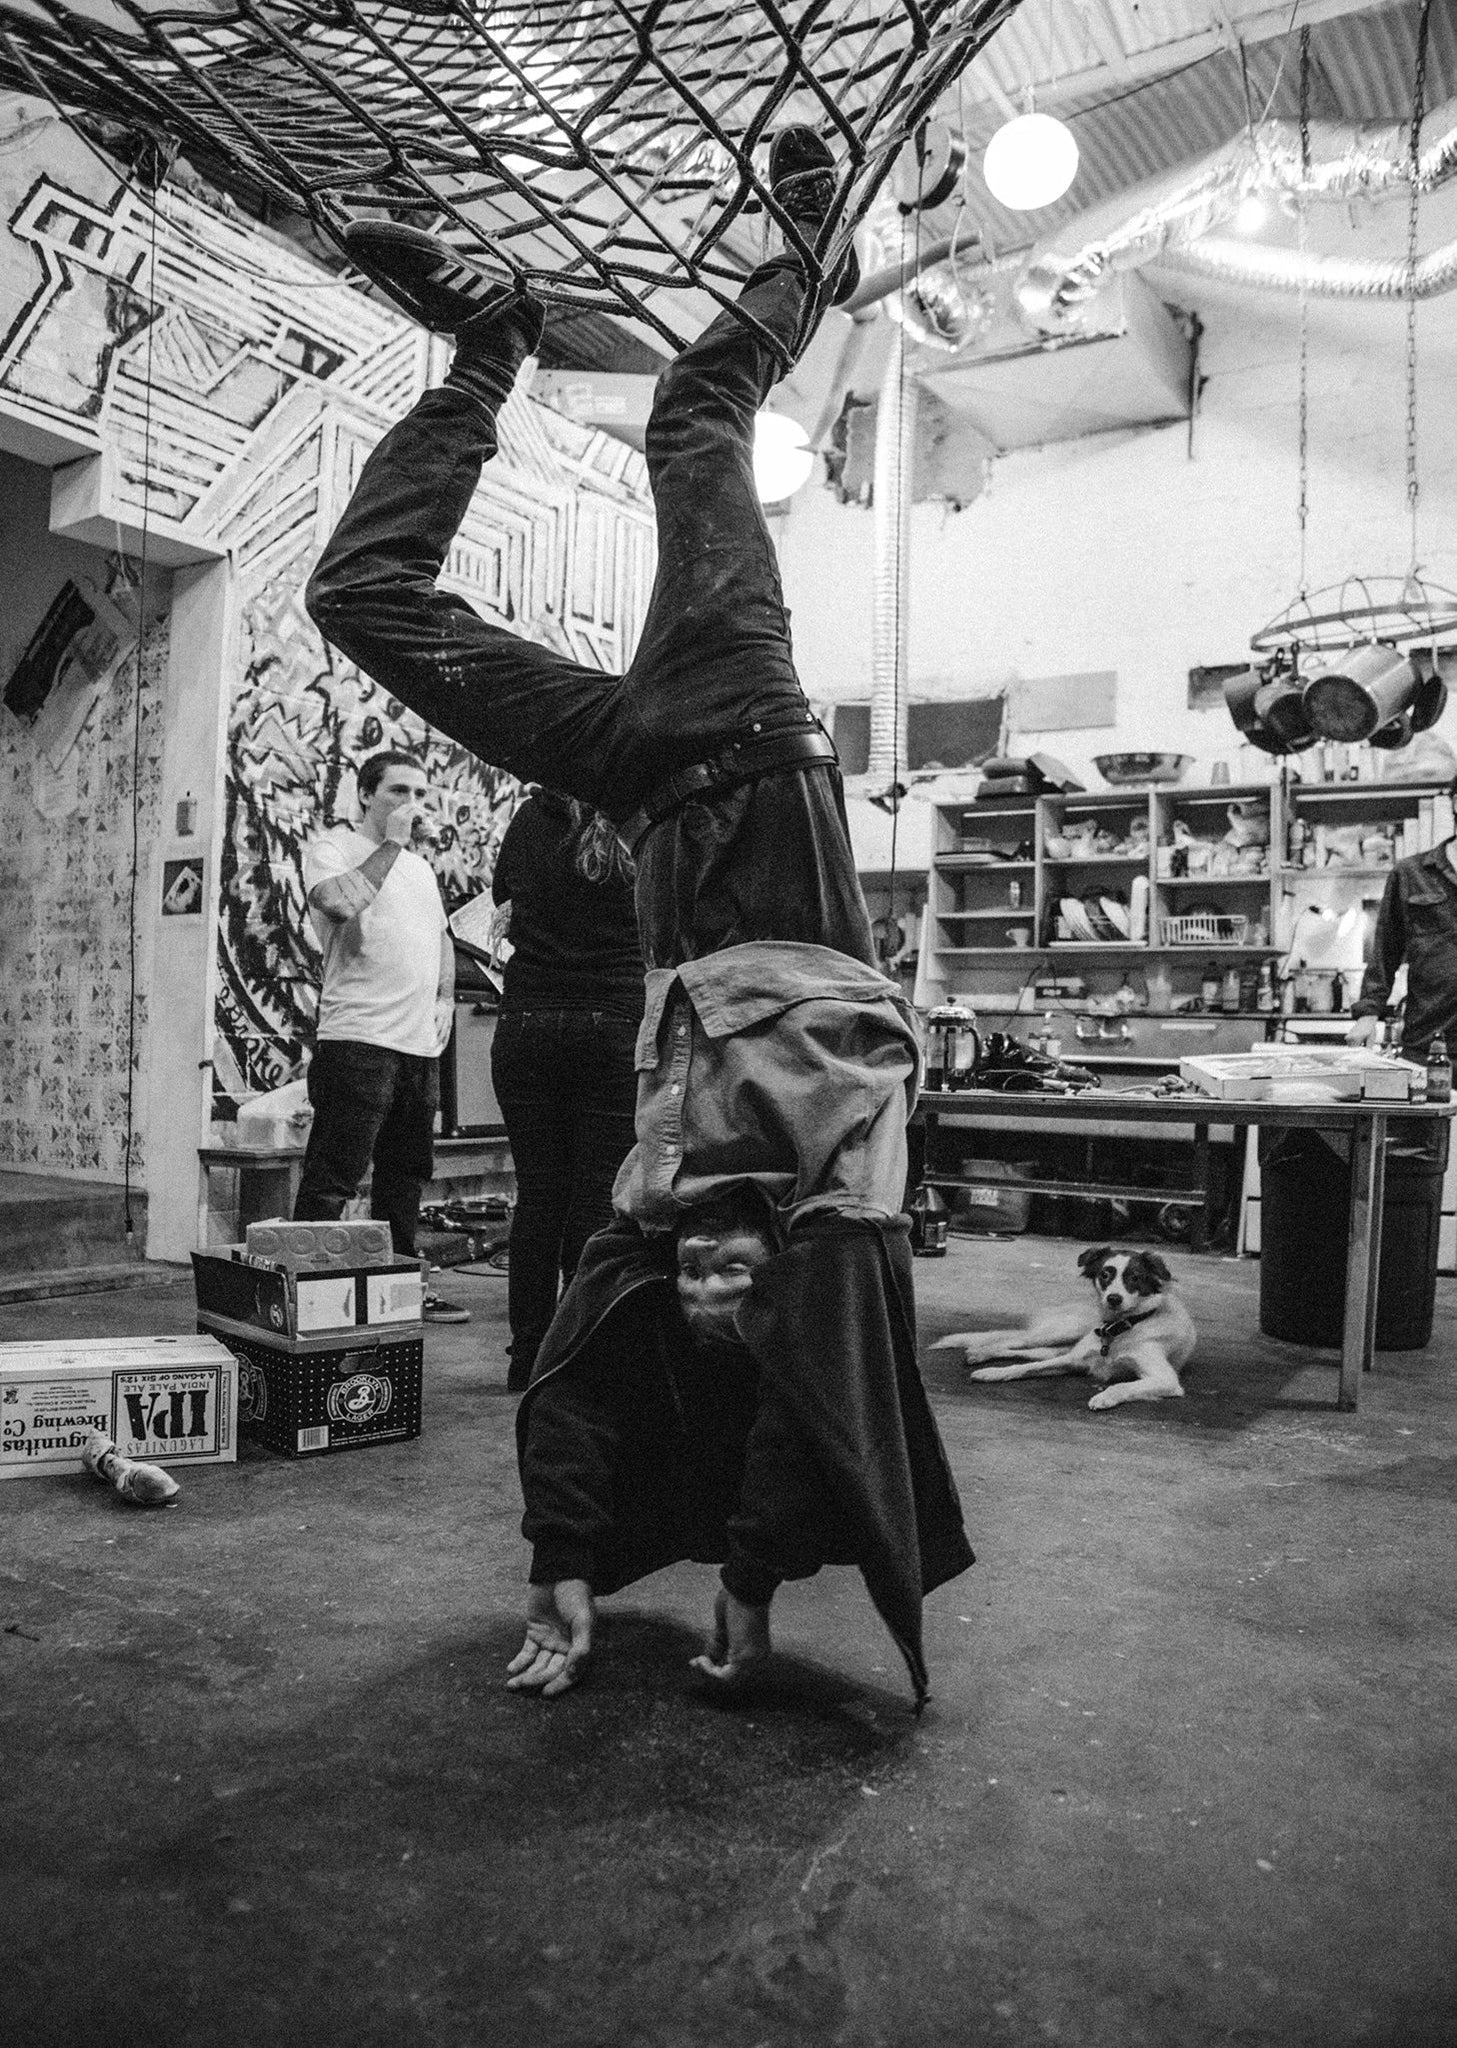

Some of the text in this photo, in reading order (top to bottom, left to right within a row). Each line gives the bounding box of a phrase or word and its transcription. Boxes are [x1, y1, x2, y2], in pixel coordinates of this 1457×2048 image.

[123, 1381, 210, 1392] INDIA PALE ALE
[341, 1375, 380, 1395] BROOKLYN
[33, 1413, 108, 1432] Brewing
[124, 1390, 209, 1441] IPA
[346, 1408, 374, 1421] LAGER
[2, 1433, 88, 1457] gunitas
[126, 1438, 205, 1456] LAGUNITAS
